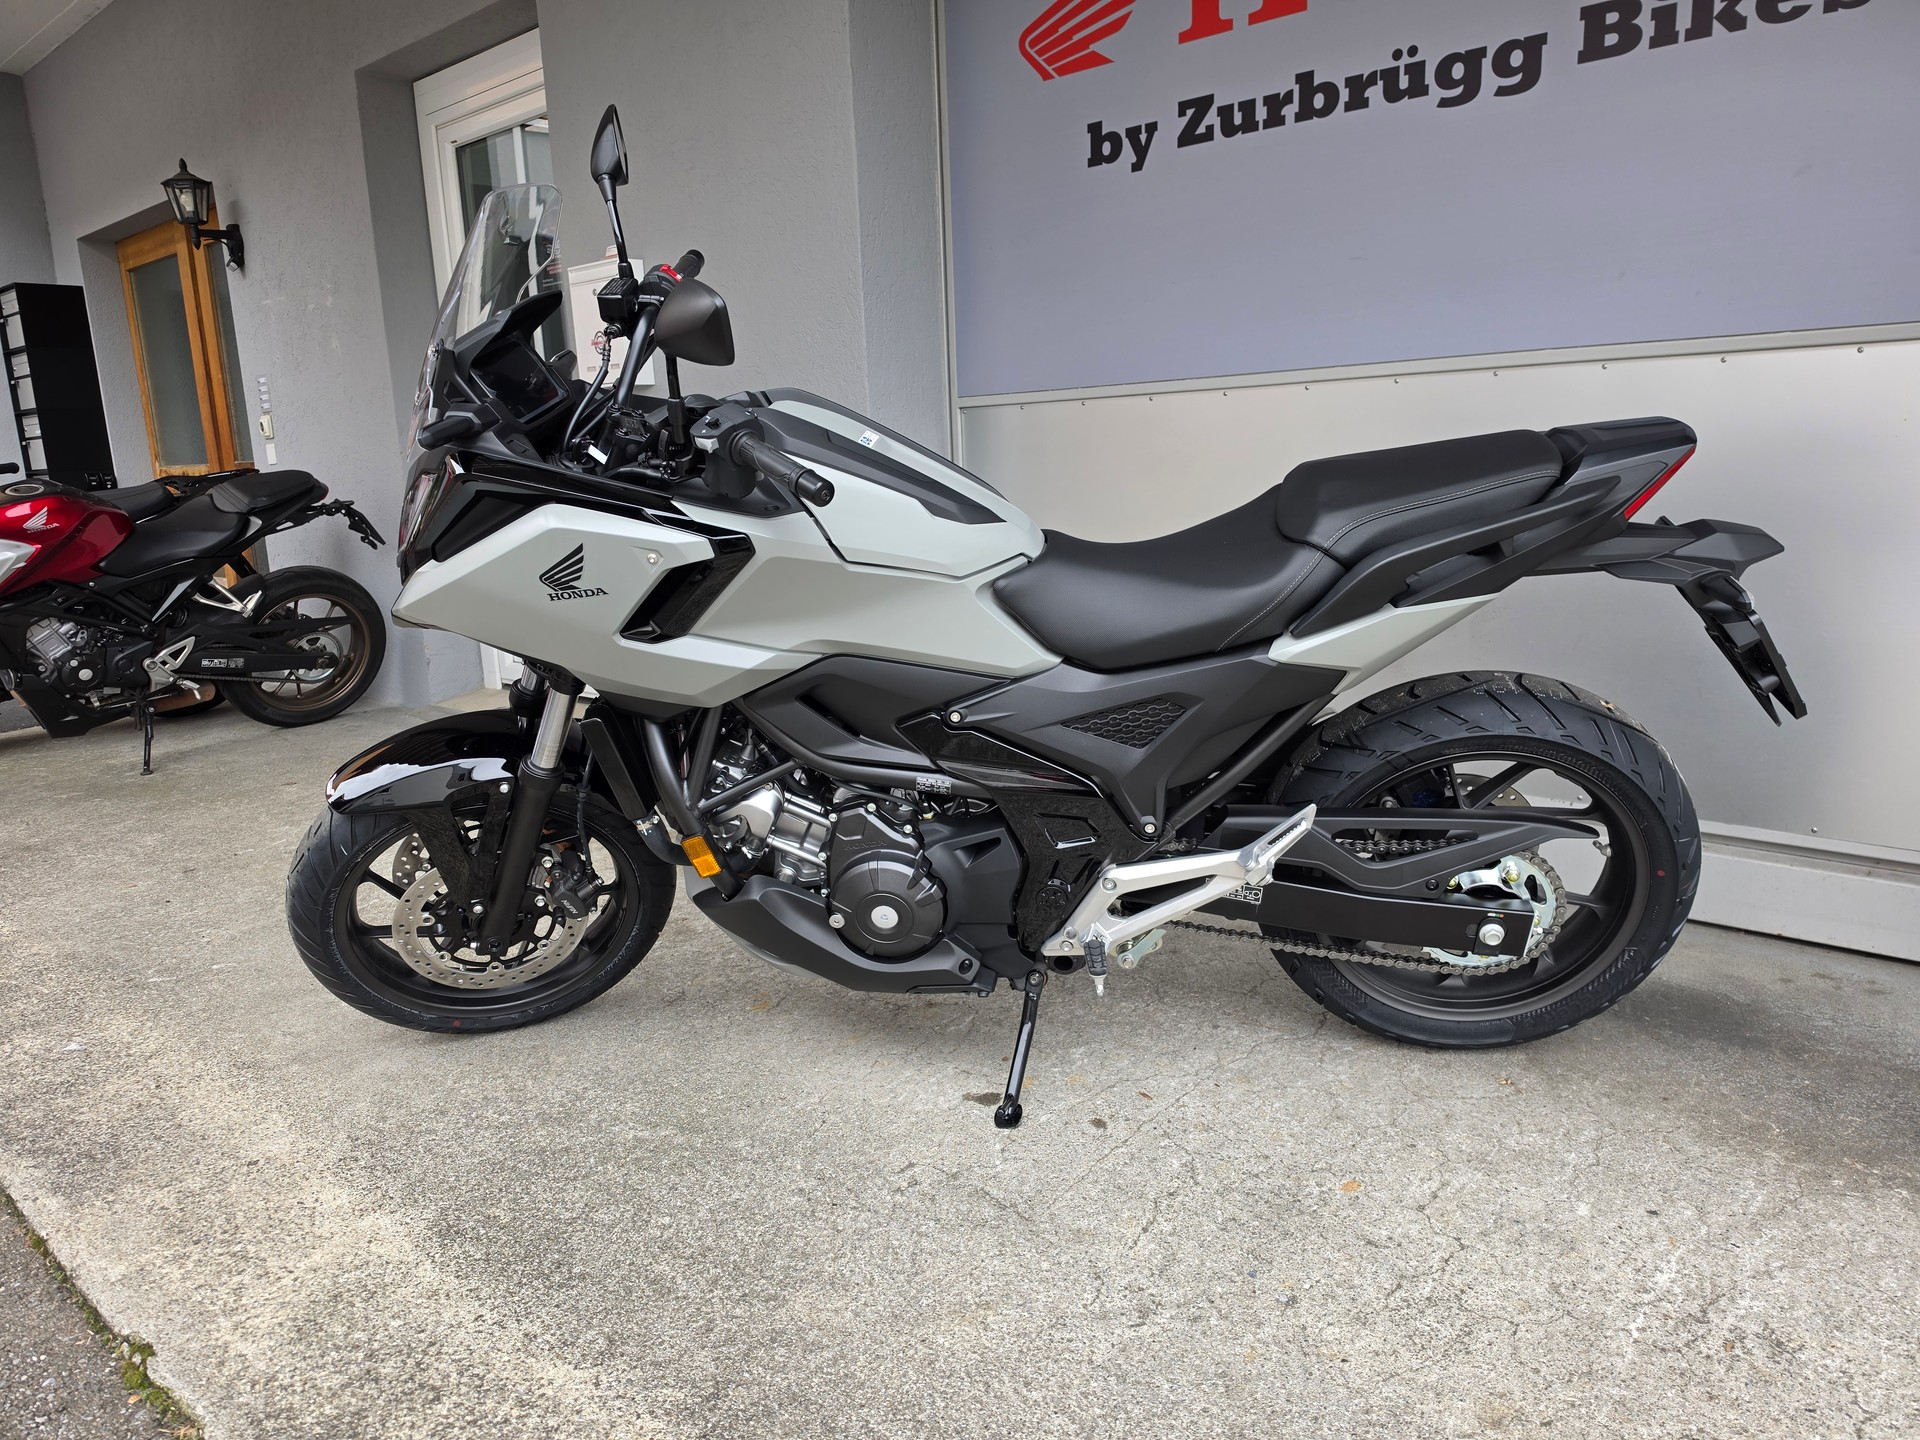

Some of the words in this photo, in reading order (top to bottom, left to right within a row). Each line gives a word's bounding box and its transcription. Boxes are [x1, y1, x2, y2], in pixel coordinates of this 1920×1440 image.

[1086, 120, 1158, 173] by
[1176, 31, 1548, 149] Zurbrügg
[547, 587, 609, 601] HONDA
[843, 840, 887, 851] HONDA
